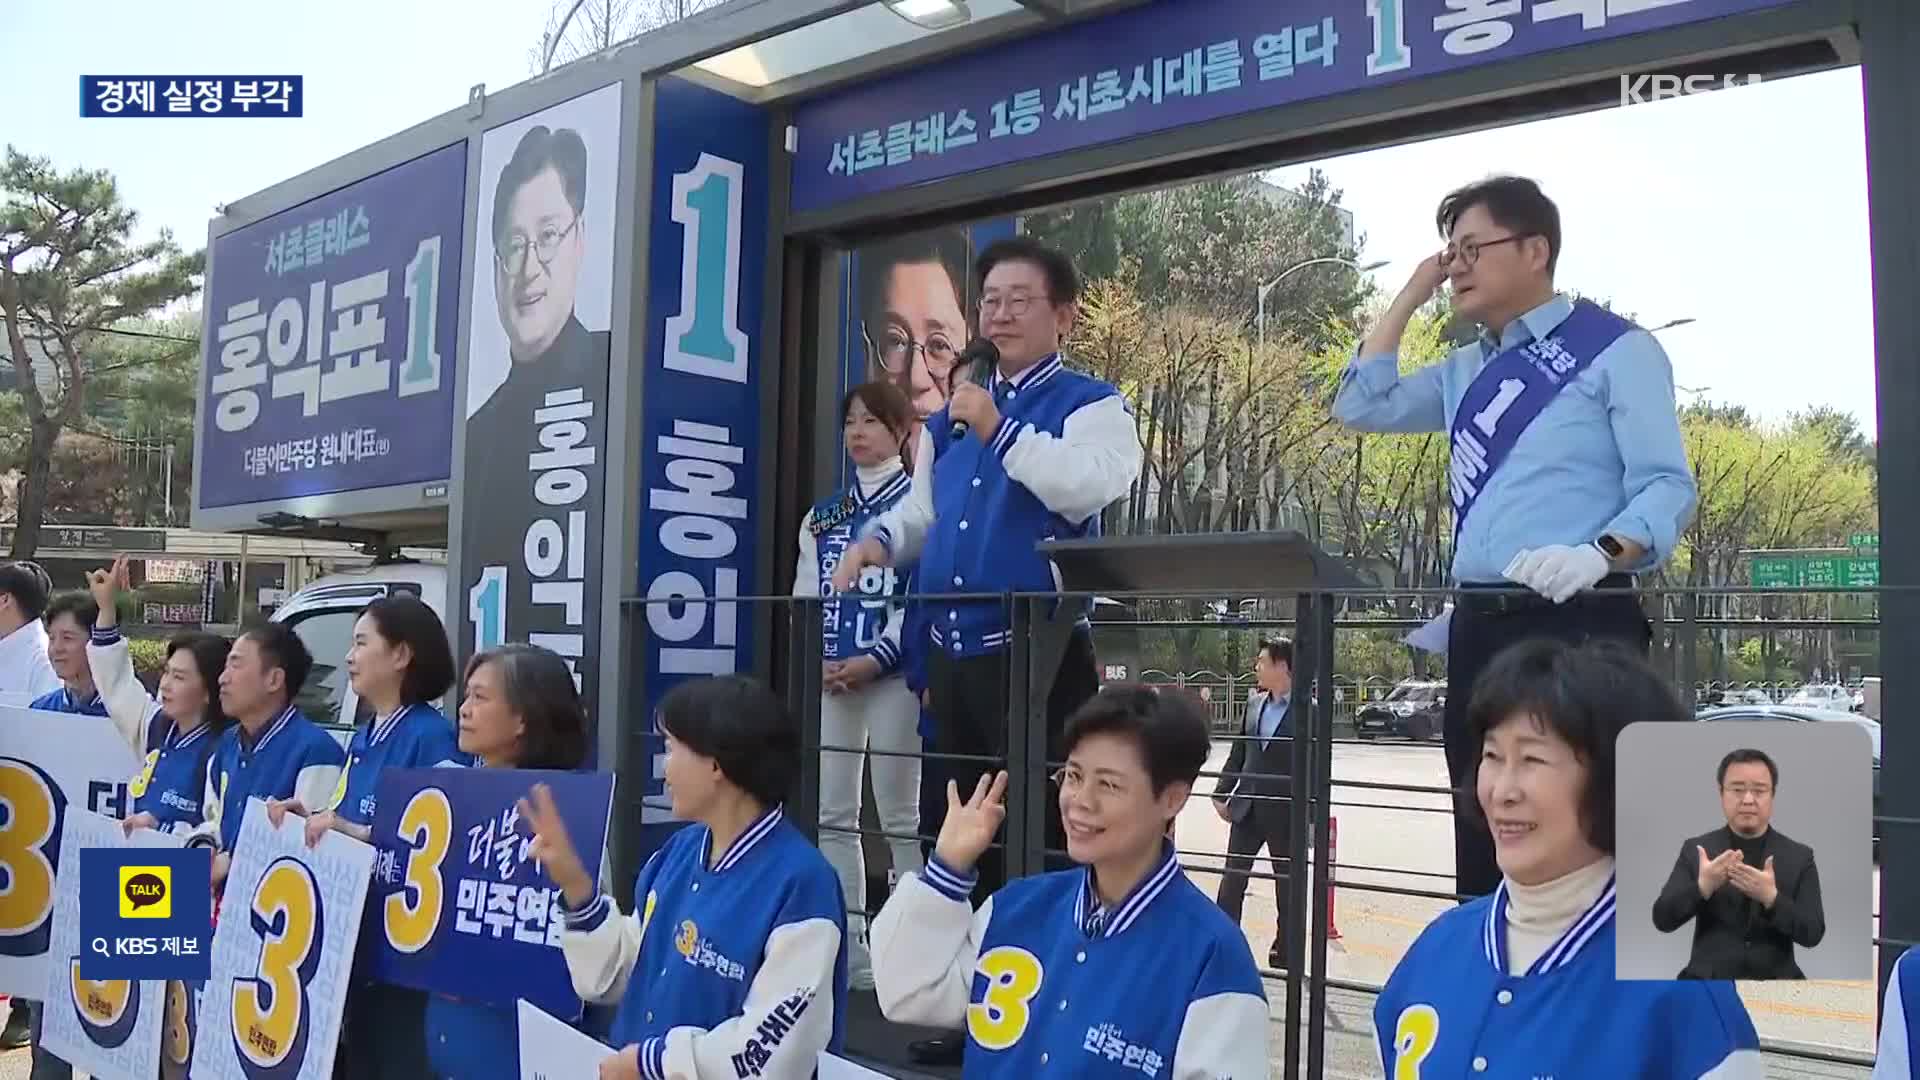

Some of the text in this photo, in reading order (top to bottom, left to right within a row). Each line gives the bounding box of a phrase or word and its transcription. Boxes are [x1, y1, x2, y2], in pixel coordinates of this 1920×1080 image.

[827, 109, 978, 177] 서초클래스
[989, 89, 1045, 140] 1등
[1052, 39, 1244, 122] 서초시대를
[1252, 16, 1339, 82] 열다
[265, 206, 370, 277] 서초클래스
[663, 152, 748, 384] 1
[212, 235, 441, 432] 홍익표 1
[244, 437, 319, 476] 더불어민주당
[1472, 378, 1526, 439] 1
[469, 566, 507, 655] 1
[1105, 665, 1127, 681] BUS
[384, 786, 453, 953] 3
[231, 857, 322, 1069] 3
[967, 945, 1045, 1051] 3
